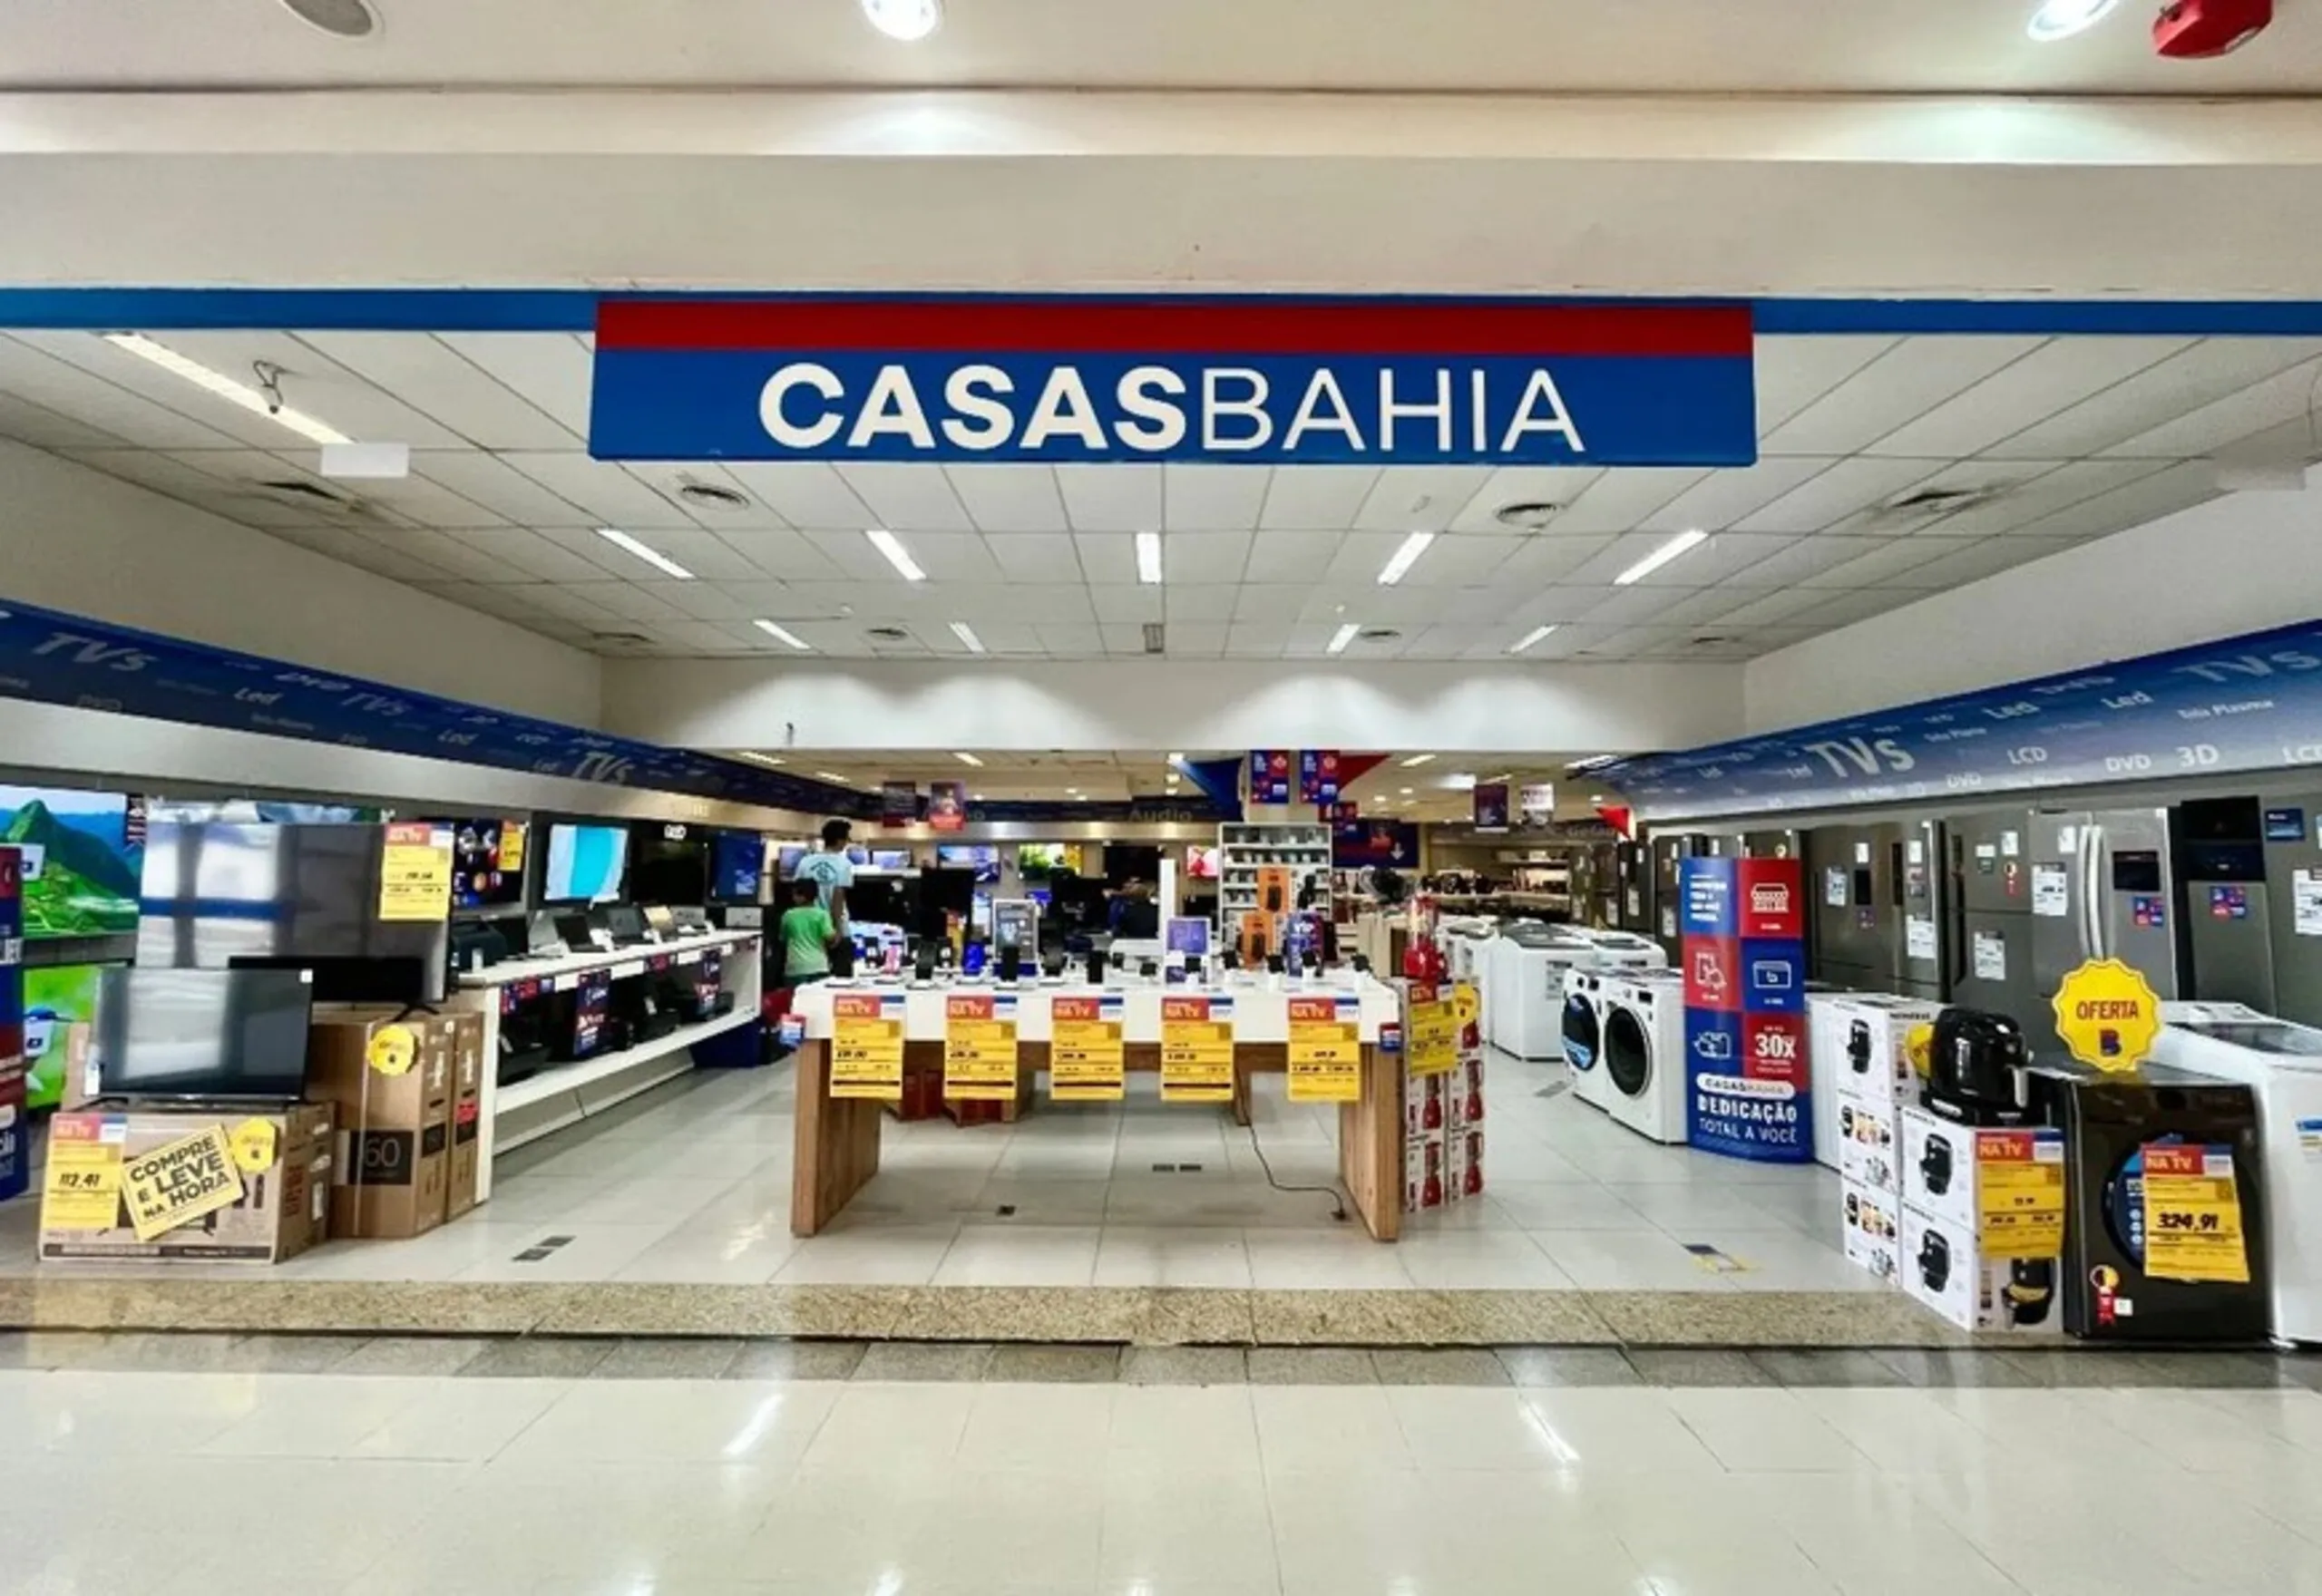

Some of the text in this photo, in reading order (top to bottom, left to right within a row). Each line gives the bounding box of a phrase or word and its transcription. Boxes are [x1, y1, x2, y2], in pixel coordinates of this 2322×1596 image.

[33, 633, 161, 671] TVs
[2171, 650, 2321, 683] TVs
[1803, 735, 1916, 778] TVs
[2006, 745, 2048, 765] LCD
[2103, 754, 2152, 773] DVD
[2175, 744, 2220, 767] 3D
[2075, 1000, 2139, 1020] OFERTA
[1744, 1125, 1755, 1140] A
[130, 1135, 218, 1182] COMPRE
[2171, 1157, 2192, 1170] TV
[137, 1150, 225, 1203] E LEVE
[143, 1171, 231, 1218] NA HORA
